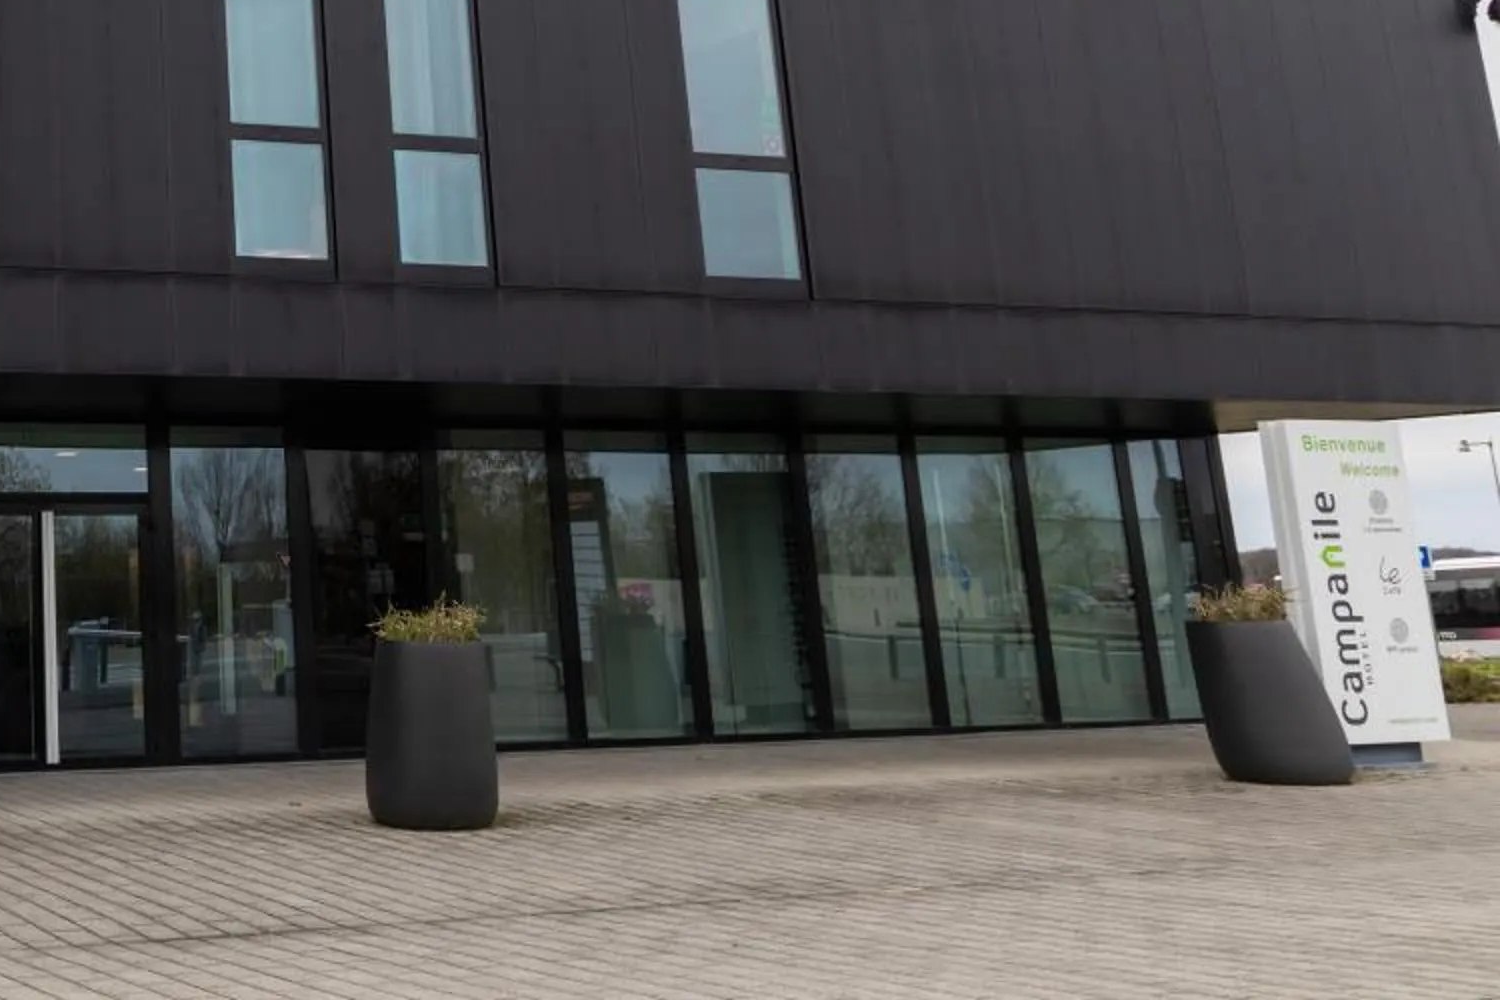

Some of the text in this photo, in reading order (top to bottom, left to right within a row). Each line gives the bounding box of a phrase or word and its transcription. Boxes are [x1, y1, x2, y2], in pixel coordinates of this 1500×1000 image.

[1301, 434, 1387, 453] Bienvenue
[1340, 461, 1401, 478] Welcome
[1311, 490, 1369, 727] Campanile
